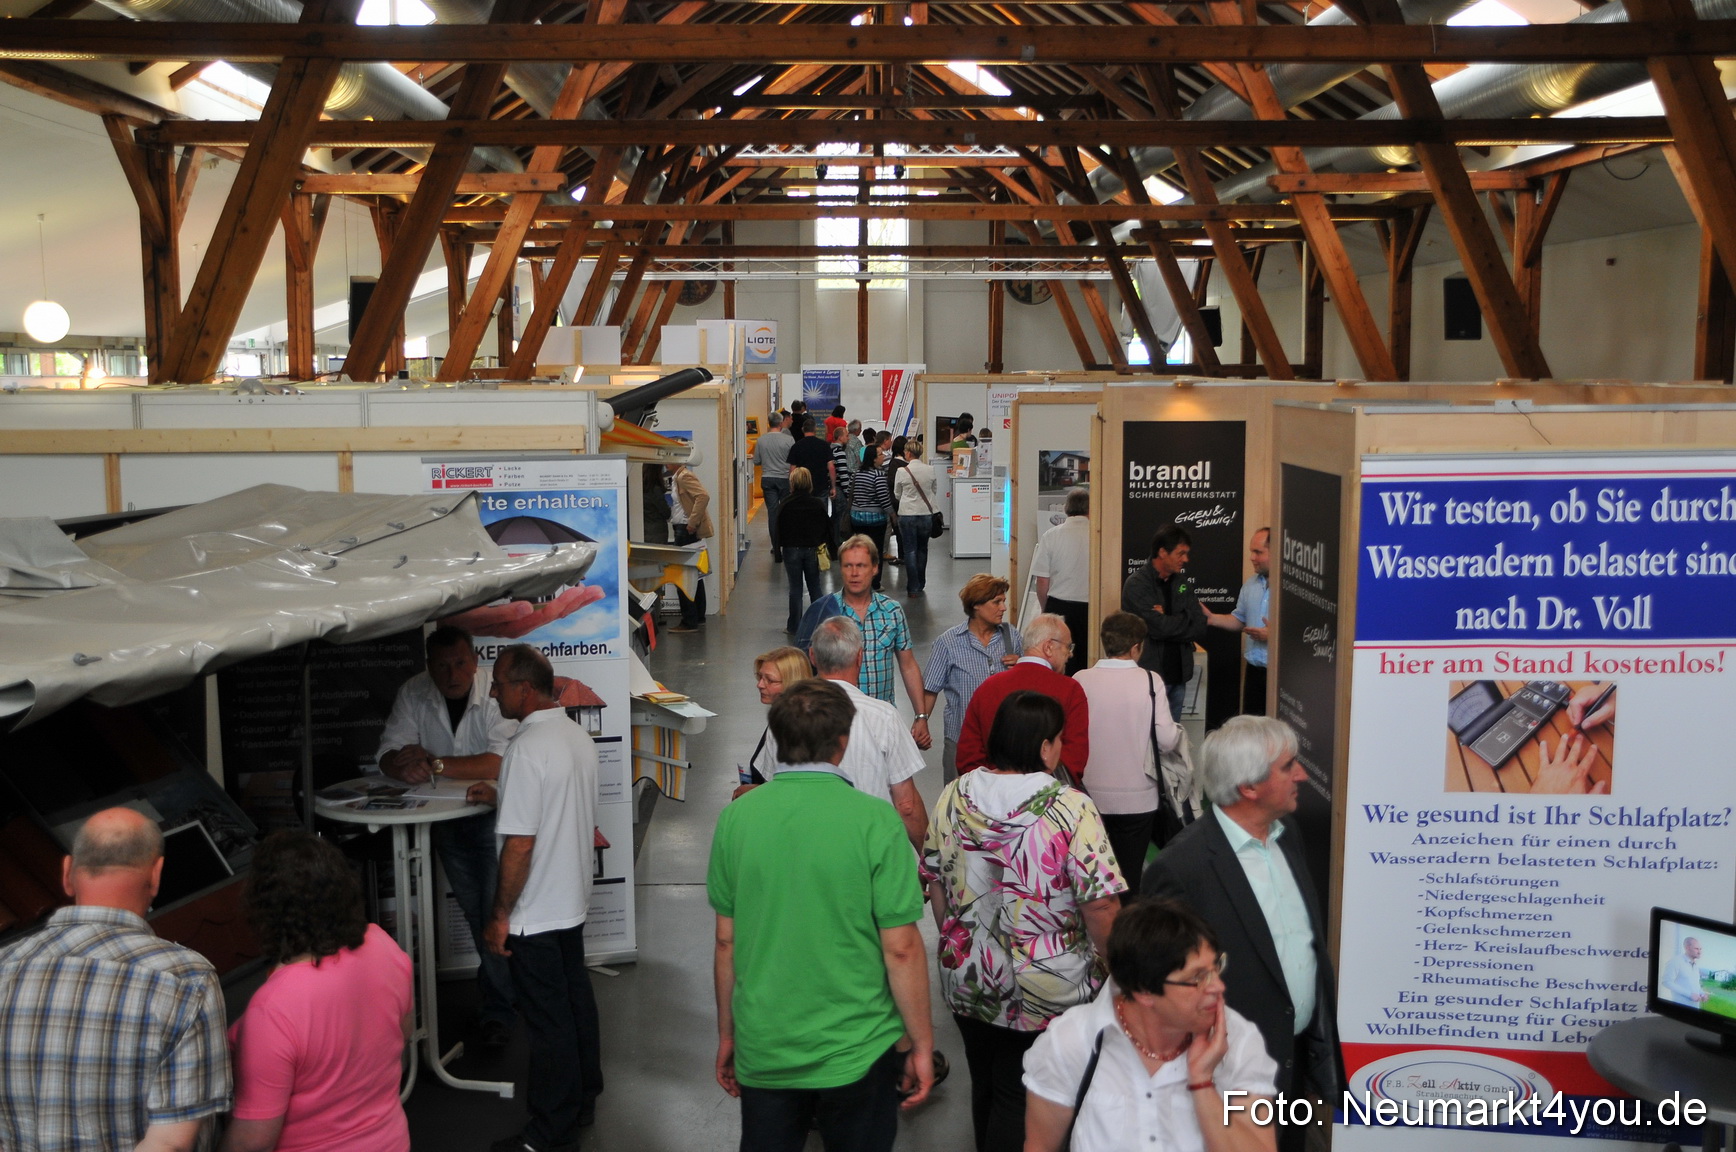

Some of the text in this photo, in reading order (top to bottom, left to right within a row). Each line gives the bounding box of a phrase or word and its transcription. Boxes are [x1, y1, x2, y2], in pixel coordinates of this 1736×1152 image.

[1129, 461, 1211, 480] brandl
[1128, 491, 1237, 499] SCHREINERWERKSTATT
[1129, 481, 1211, 489] HILPOLTSTEIN
[514, 493, 610, 510] erhalten.
[1379, 490, 1437, 525] Wir
[1444, 494, 1541, 531] testen,
[1549, 487, 1587, 523] ob
[1596, 487, 1643, 523] Sie
[1282, 530, 1324, 576] brandl
[1366, 541, 1554, 578] Wasseradern
[1563, 541, 1678, 577] belastet
[1282, 561, 1324, 591] HILPOLTSTEIN
[1281, 578, 1338, 616] SCHREINERWERKSTATT
[1455, 594, 1652, 630] nach Dr. Voll
[1379, 650, 1726, 675] hier am Stand kostenlos!
[1362, 804, 1733, 832] Wie gesund ist Ihr Schlafplatz?
[1411, 833, 1677, 850] Anzeichen für einen durch
[1369, 851, 1719, 873] Wasseradern belasteten Schlafplatz:
[1474, 940, 1650, 959] Kreislaufbeschwerde
[1545, 977, 1648, 993] Beschwerde
[1397, 990, 1430, 1005] Ein
[1434, 992, 1524, 1008] gesunder
[1529, 995, 1638, 1016] Schlafplatz
[1382, 1007, 1519, 1026] Voraussetzung
[1526, 1010, 1555, 1027] für
[1365, 1022, 1500, 1041] Wohlbefinden
[1507, 1027, 1544, 1042] und
[1386, 1079, 1405, 1088] F.B.
[1407, 1075, 1436, 1089] Zell
[1439, 1077, 1480, 1092] Aktiv
